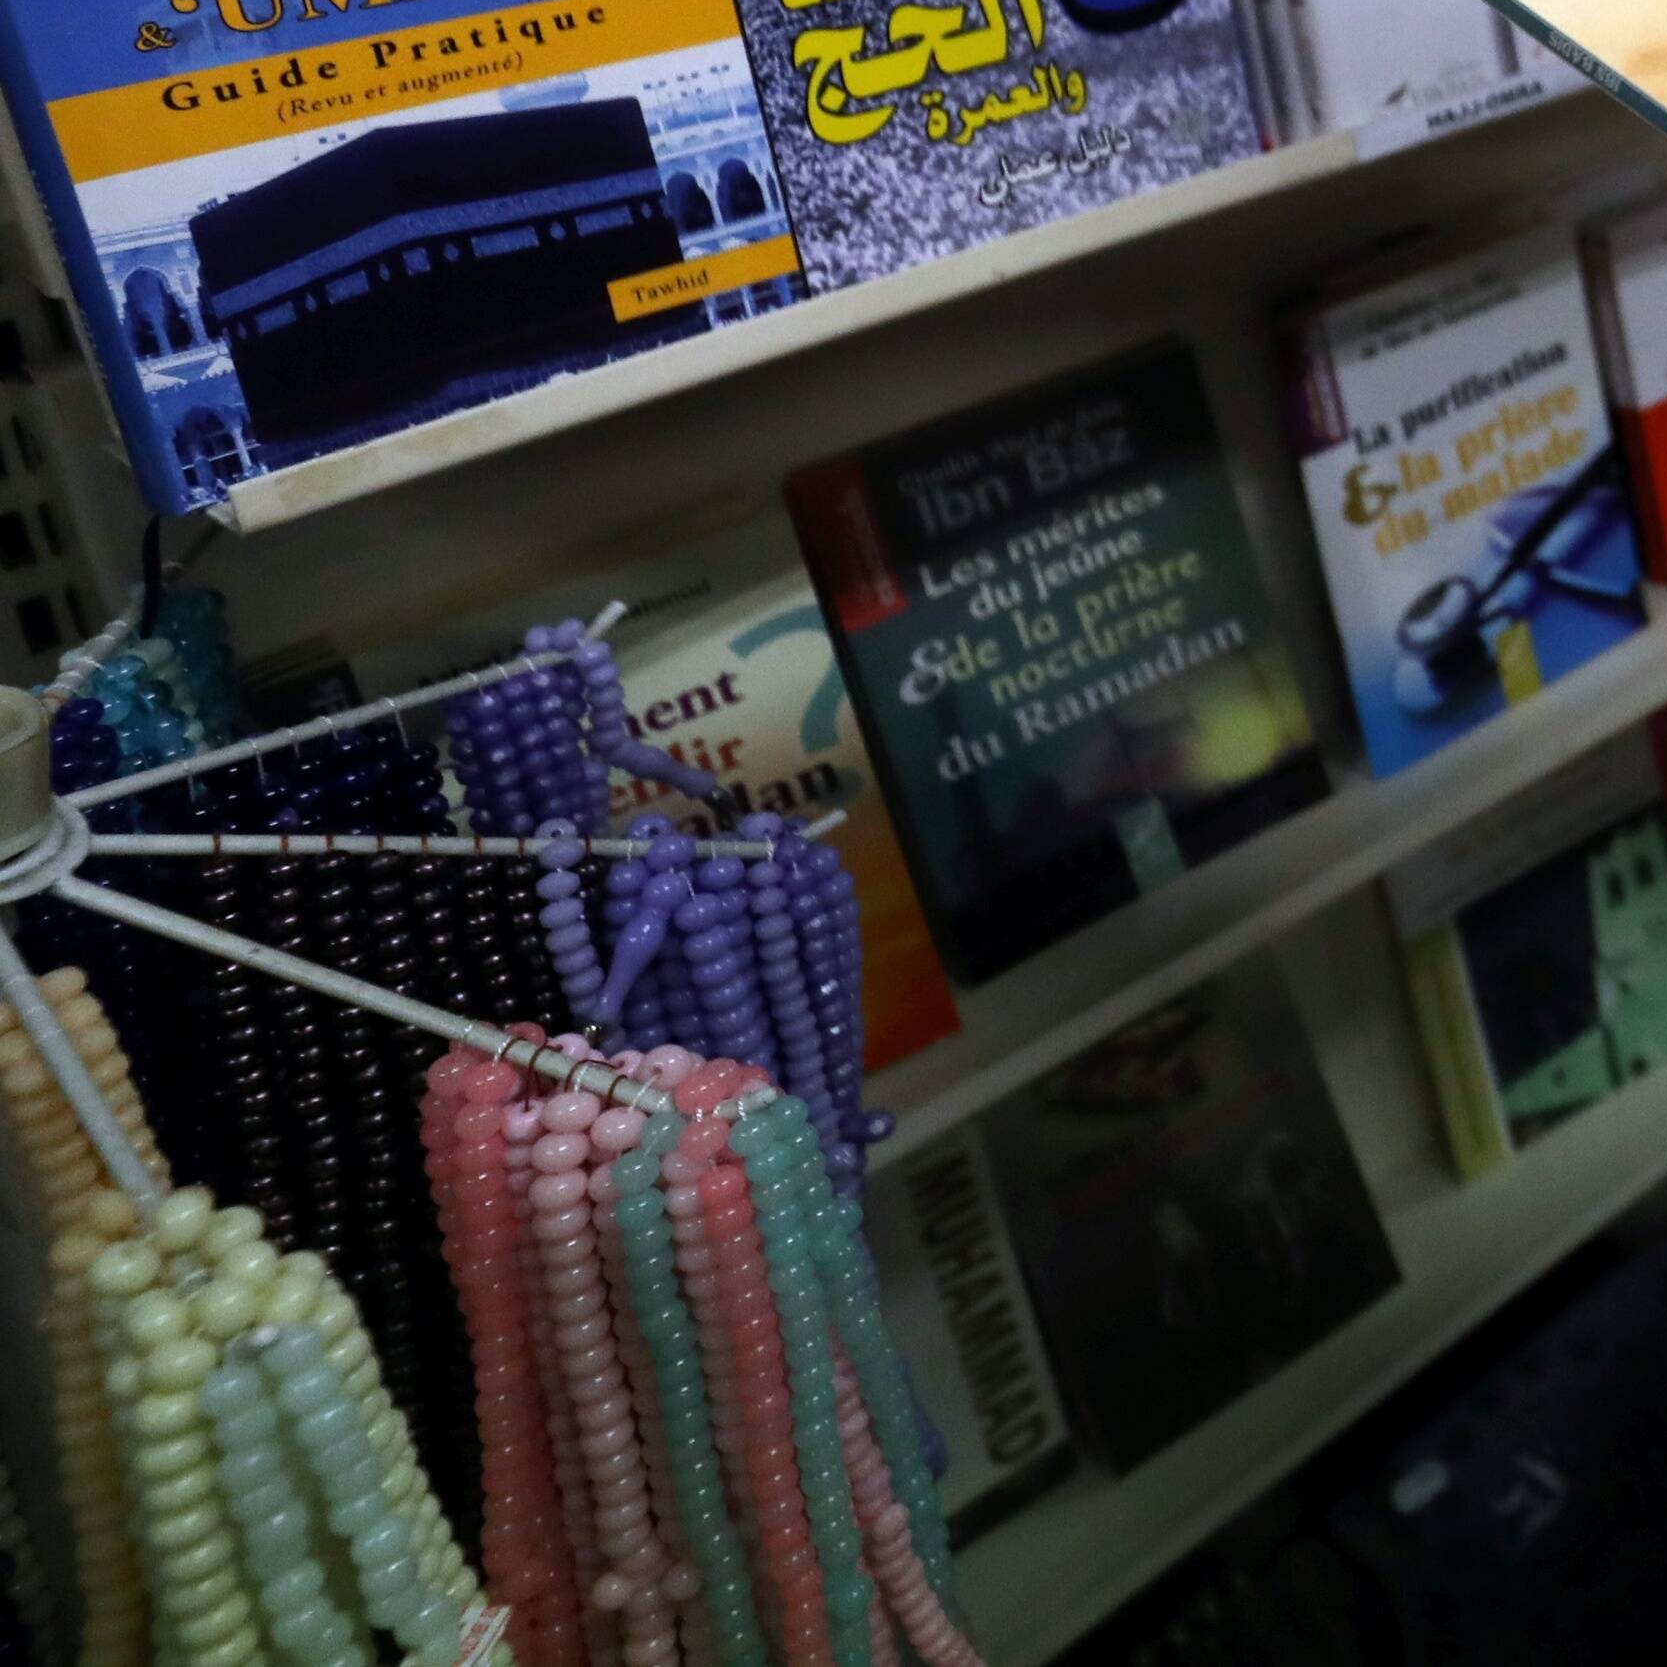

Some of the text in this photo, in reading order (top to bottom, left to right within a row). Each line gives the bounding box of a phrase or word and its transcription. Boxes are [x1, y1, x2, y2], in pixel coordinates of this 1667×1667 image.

[134, 21, 178, 53] &
[161, 3, 607, 112] Guide Pratique
[276, 50, 524, 124] (Revu et augmenté)
[920, 62, 1088, 147] والعمرة
[630, 269, 710, 304] Tawhid
[1352, 342, 1568, 455] La purification
[915, 476, 1012, 537] Ibn
[1374, 429, 1586, 558] du malade
[1397, 451, 1442, 493] la
[917, 481, 1167, 601] Les mérites
[967, 529, 1145, 622] du jeûne
[945, 632, 1002, 682] de
[1011, 609, 1061, 651] la
[1074, 549, 1202, 640] prière
[989, 598, 1187, 707] nocturne
[937, 617, 1247, 782] du Ramadan
